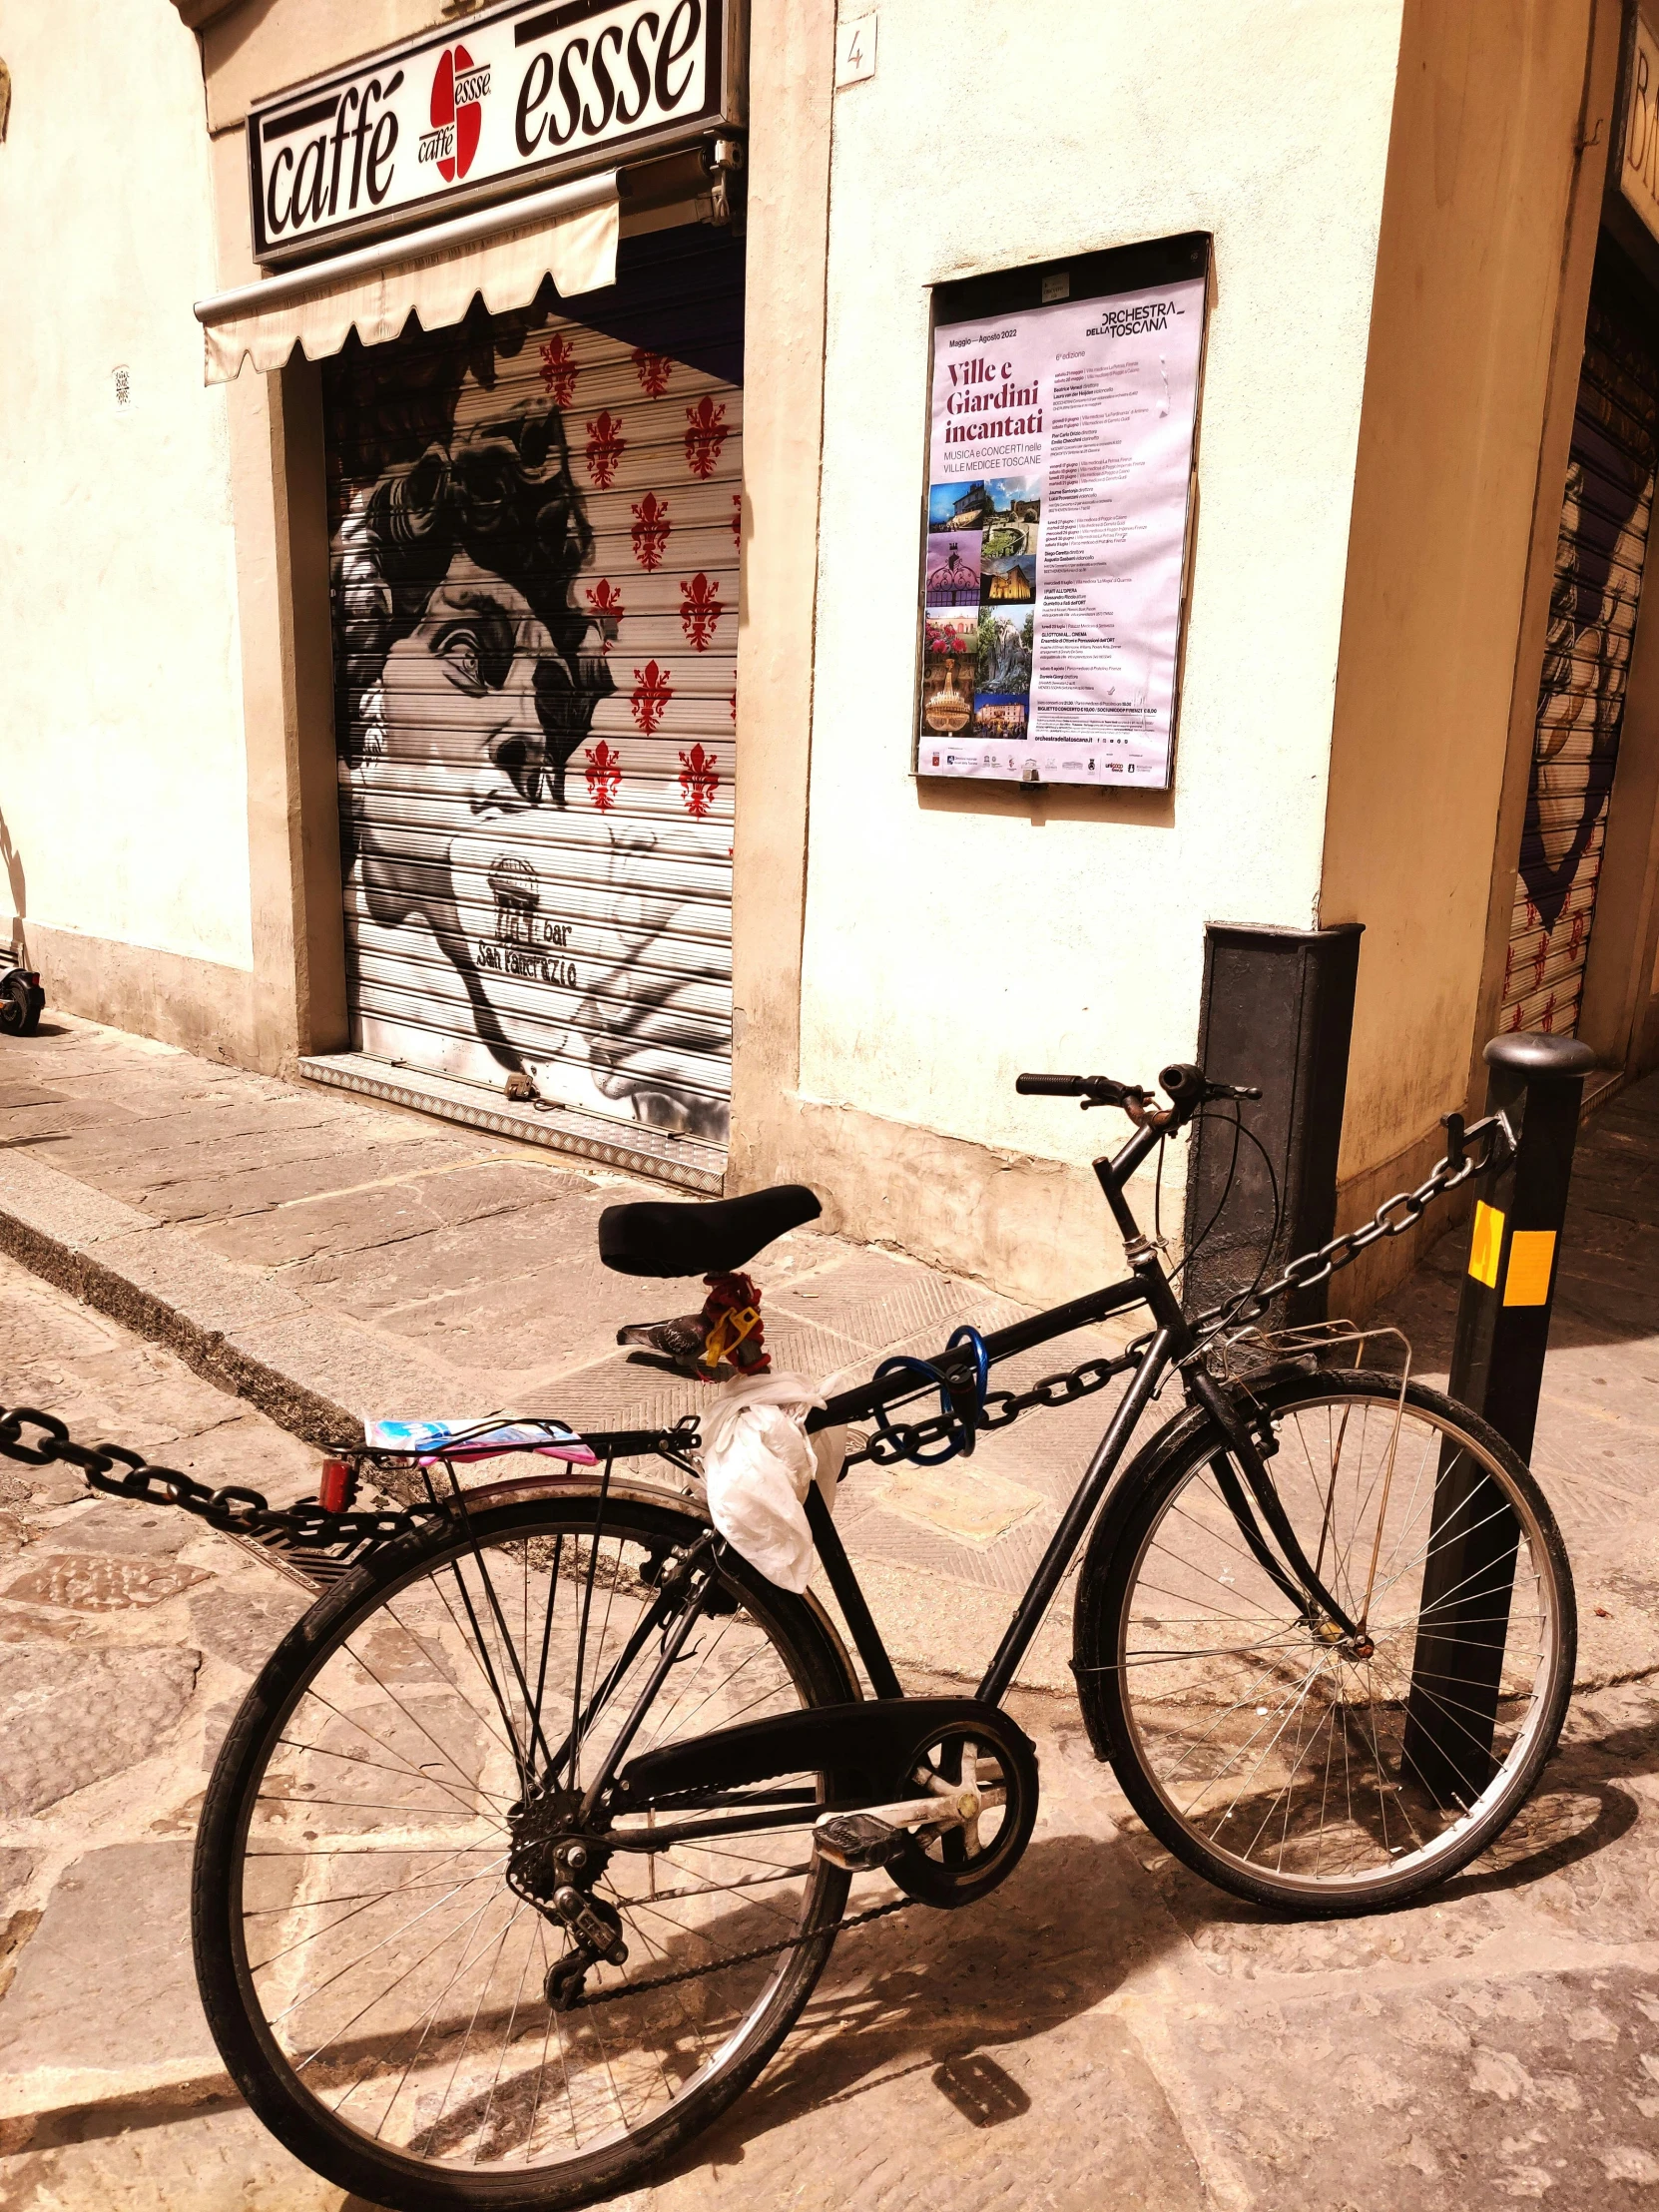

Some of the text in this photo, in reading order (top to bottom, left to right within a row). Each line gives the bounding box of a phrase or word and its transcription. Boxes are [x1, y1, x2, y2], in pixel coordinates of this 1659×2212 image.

[847, 30, 863, 69] 4
[454, 71, 490, 105] essse
[514, 0, 701, 158] essse
[948, 328, 1016, 348] Maggio Agosto 2022
[1086, 315, 1167, 338] DELLA TOSCANA
[1062, 349, 1085, 359] edizione
[946, 355, 1012, 387] Ville e
[946, 378, 1039, 416] Giardini
[944, 407, 1043, 444] incantati
[943, 449, 974, 461] MUSICA
[980, 443, 1023, 456] CONCERTI
[1024, 441, 1041, 451] nelle
[943, 453, 1041, 473] VILLE MEDICEE TOSCANE
[544, 919, 572, 946] bar
[477, 940, 502, 969] San
